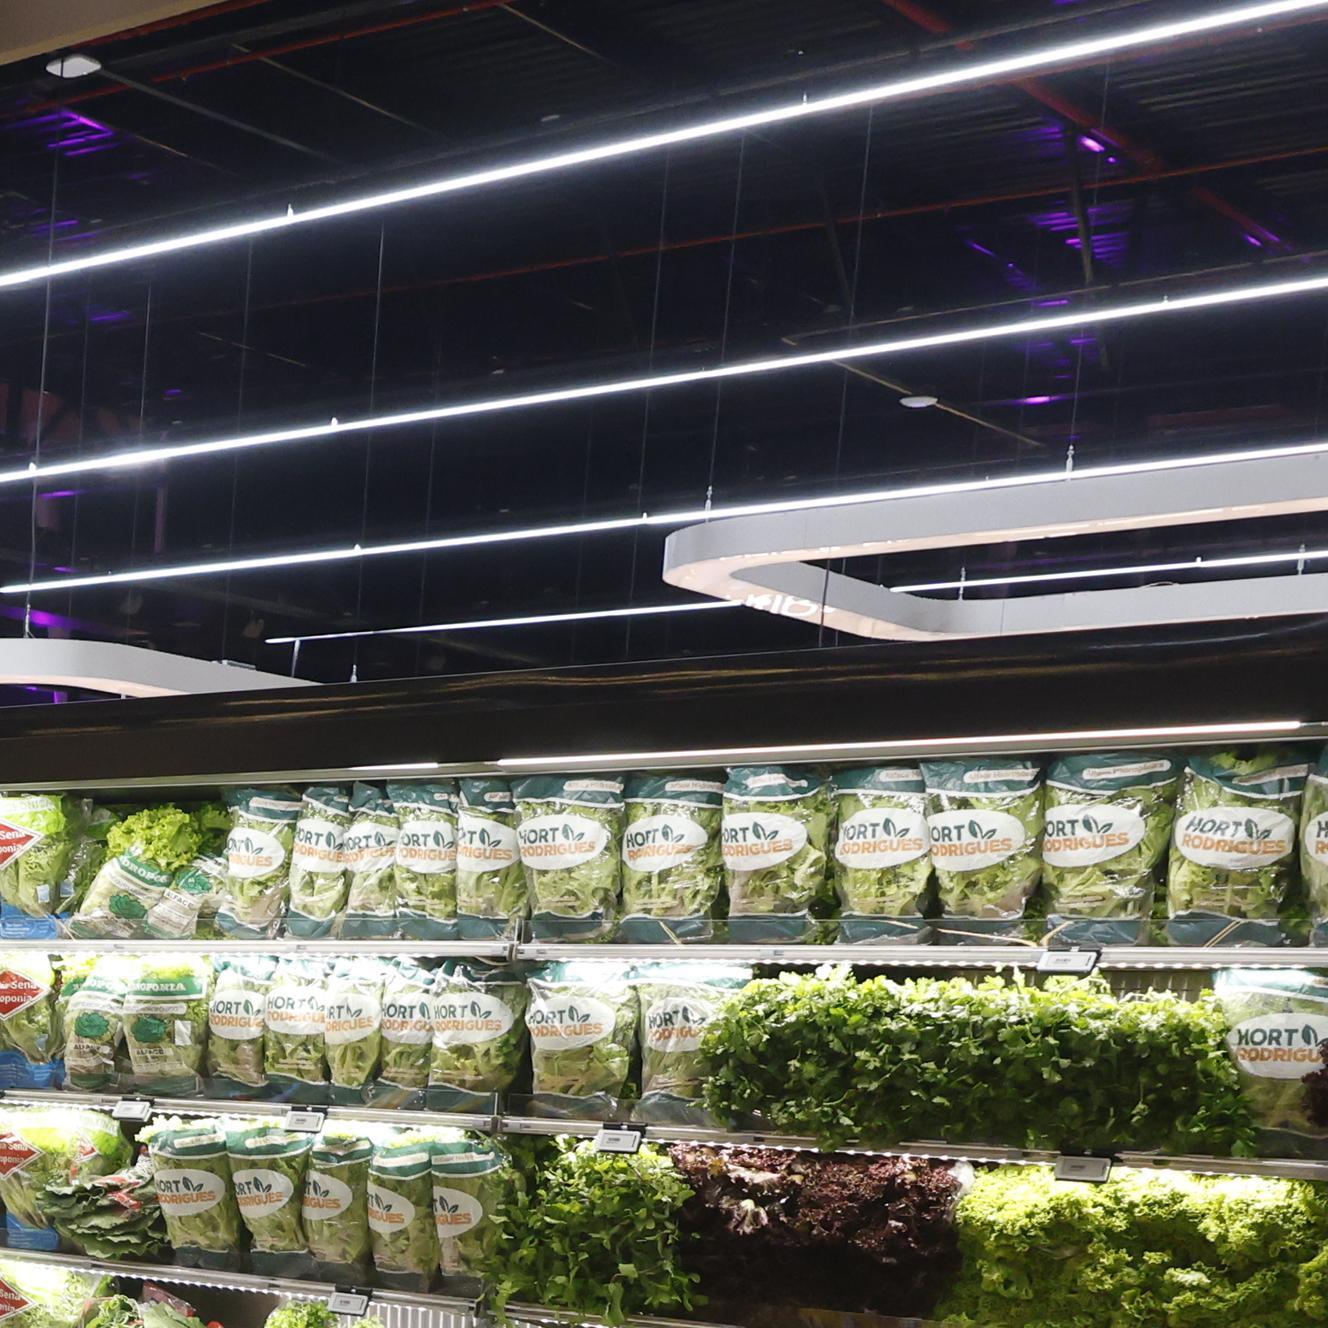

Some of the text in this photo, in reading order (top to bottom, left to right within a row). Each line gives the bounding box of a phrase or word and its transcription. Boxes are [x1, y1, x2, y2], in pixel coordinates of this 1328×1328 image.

[1185, 816, 1242, 838] HORT
[1183, 836, 1289, 856] RODRIGUES
[1237, 1028, 1299, 1046] HORT
